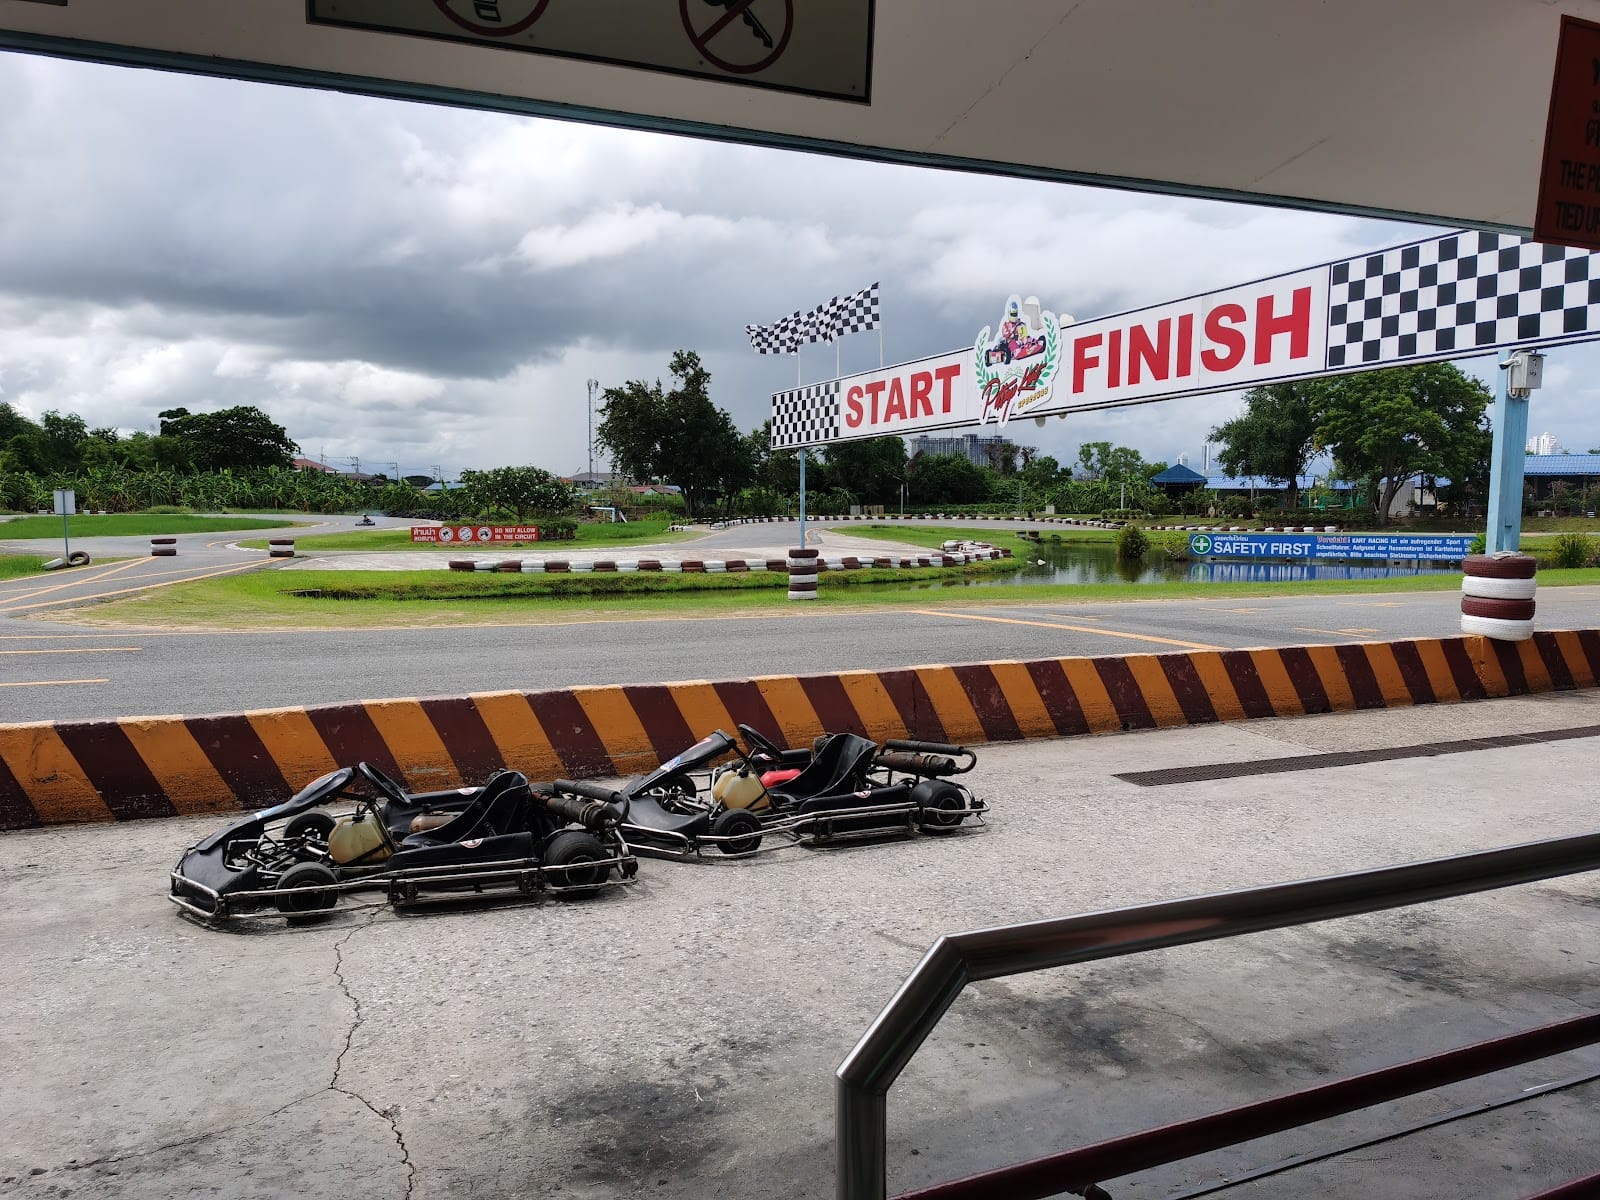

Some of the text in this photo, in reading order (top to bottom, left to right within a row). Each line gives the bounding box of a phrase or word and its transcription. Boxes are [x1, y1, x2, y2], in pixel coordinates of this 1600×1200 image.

[1560, 159, 1584, 191] THE
[1555, 200, 1584, 231] TIED
[1072, 286, 1311, 393] FINISH
[845, 364, 960, 428] START
[1213, 542, 1312, 556] SAFETY FIRST
